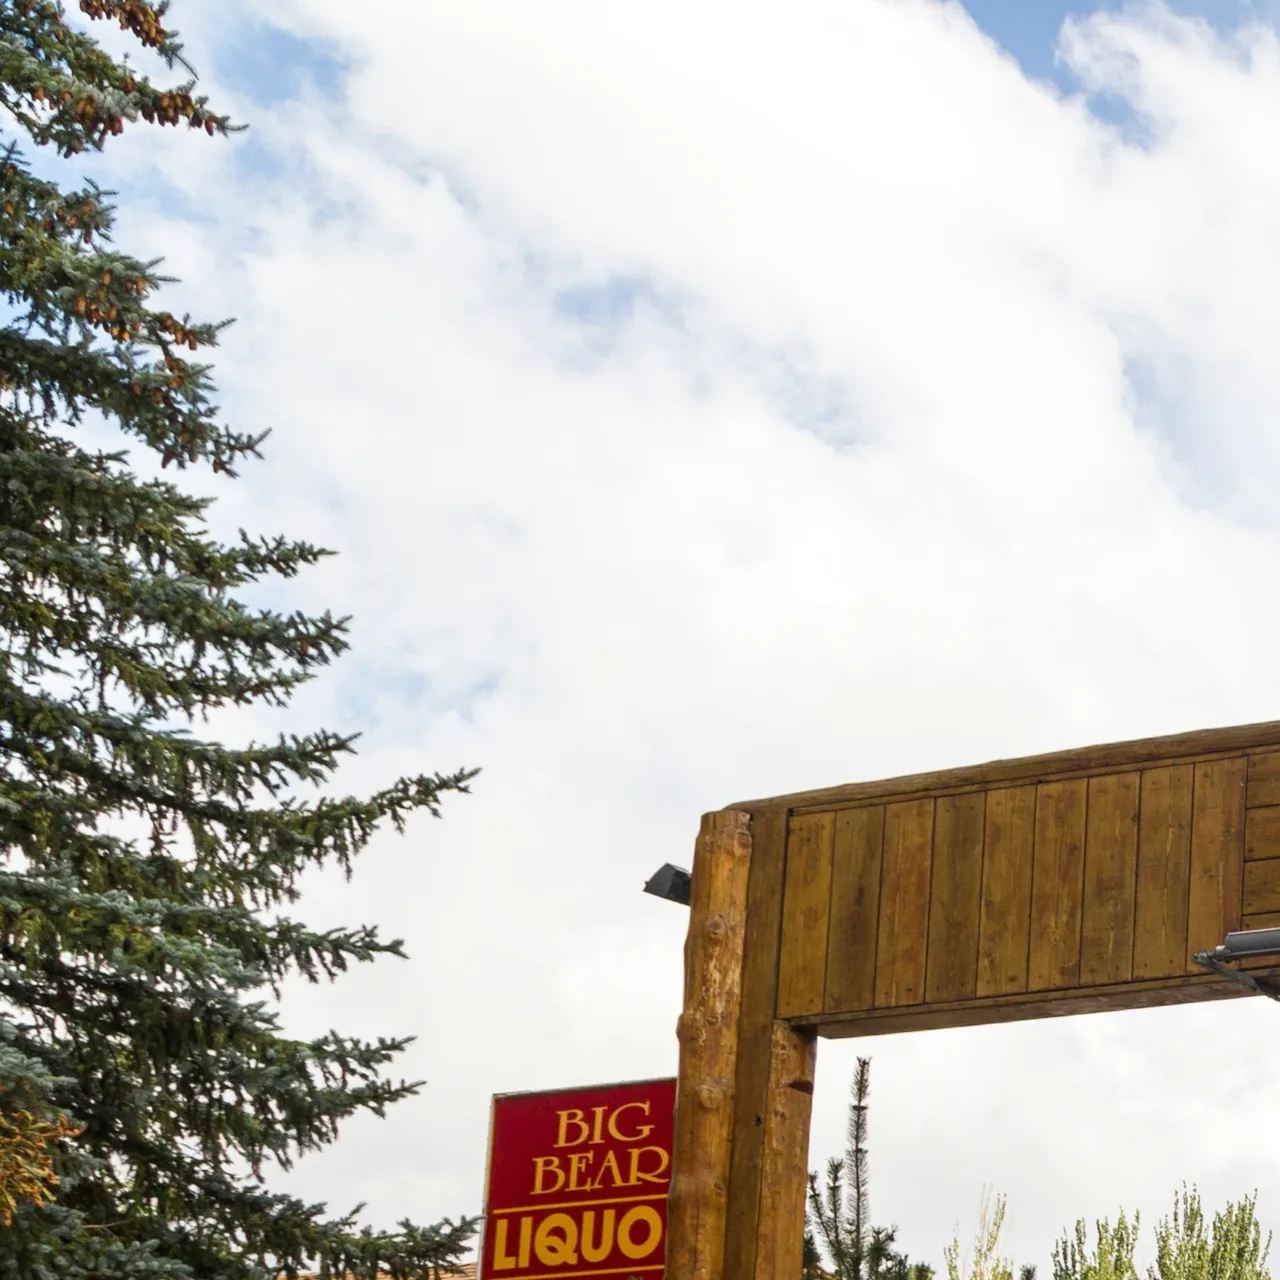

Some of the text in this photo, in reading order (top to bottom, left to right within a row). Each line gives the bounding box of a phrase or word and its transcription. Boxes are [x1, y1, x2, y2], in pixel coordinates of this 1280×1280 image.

[553, 1100, 655, 1148] BIG
[529, 1145, 670, 1196] BEAR
[492, 1204, 663, 1271] LIQUO
